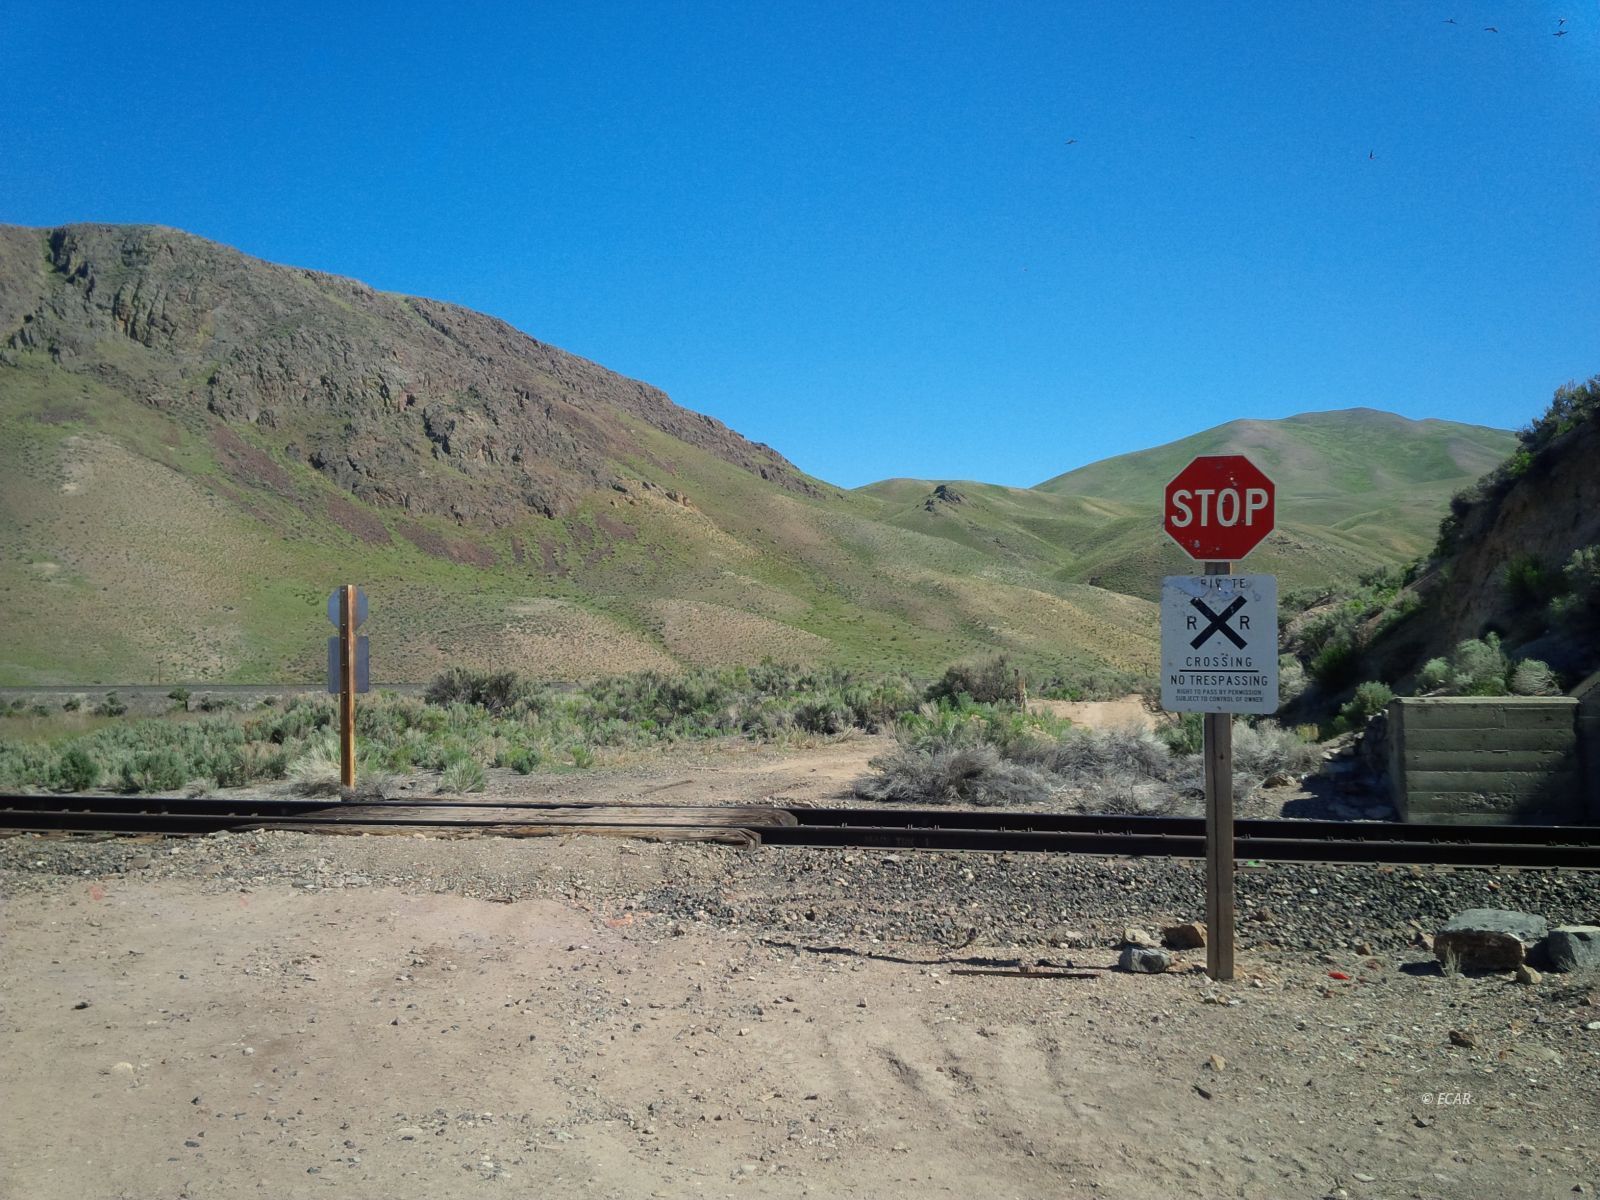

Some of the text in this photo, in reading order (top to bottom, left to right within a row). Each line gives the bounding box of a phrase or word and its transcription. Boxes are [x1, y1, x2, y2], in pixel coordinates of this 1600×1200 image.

[1171, 488, 1269, 527] STOP
[1187, 615, 1197, 630] R
[1240, 615, 1250, 630] R
[1186, 656, 1252, 667] CROSSING
[1170, 675, 1268, 686] NO TRESPASSING
